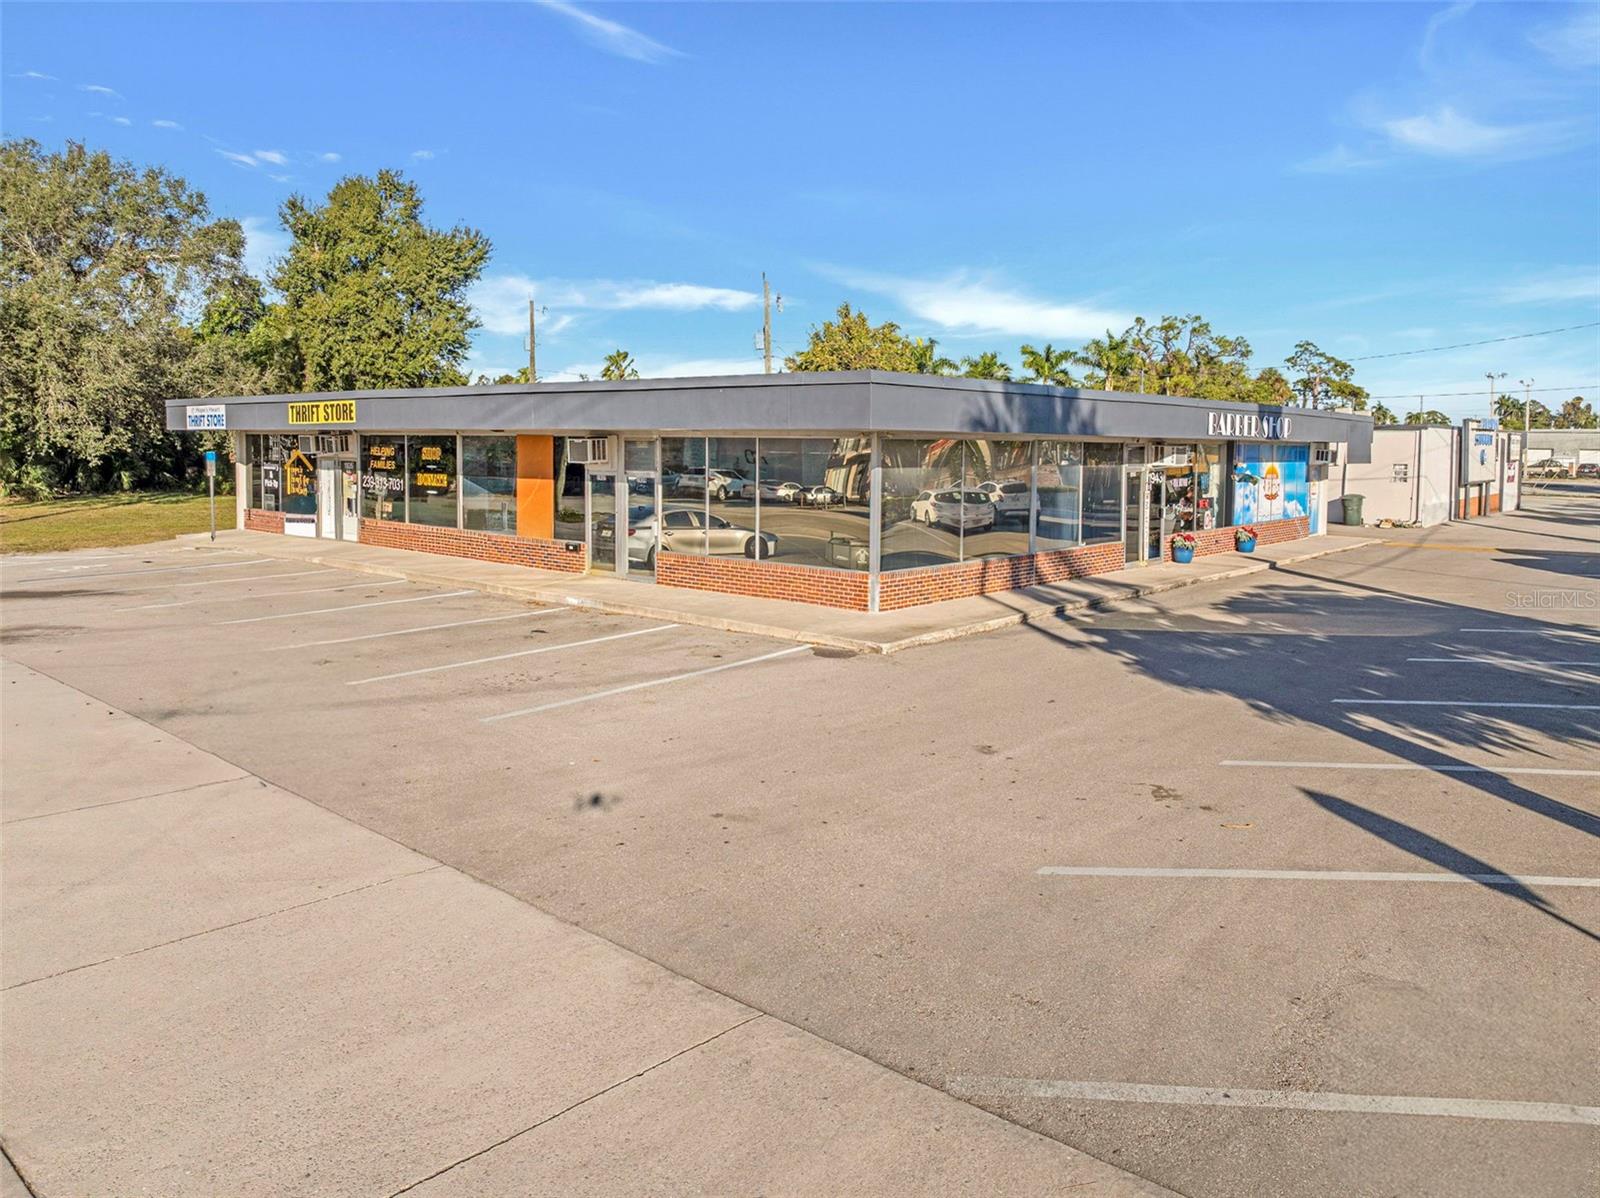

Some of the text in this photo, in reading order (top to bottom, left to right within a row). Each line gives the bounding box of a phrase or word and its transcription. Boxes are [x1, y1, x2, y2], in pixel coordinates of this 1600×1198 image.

[290, 402, 354, 423] THRIFT STORE
[188, 413, 225, 427] THRIFT STORE
[1208, 411, 1293, 439] BARBER SHOP
[369, 446, 396, 457] HELPING
[369, 459, 397, 470] FAMILIES
